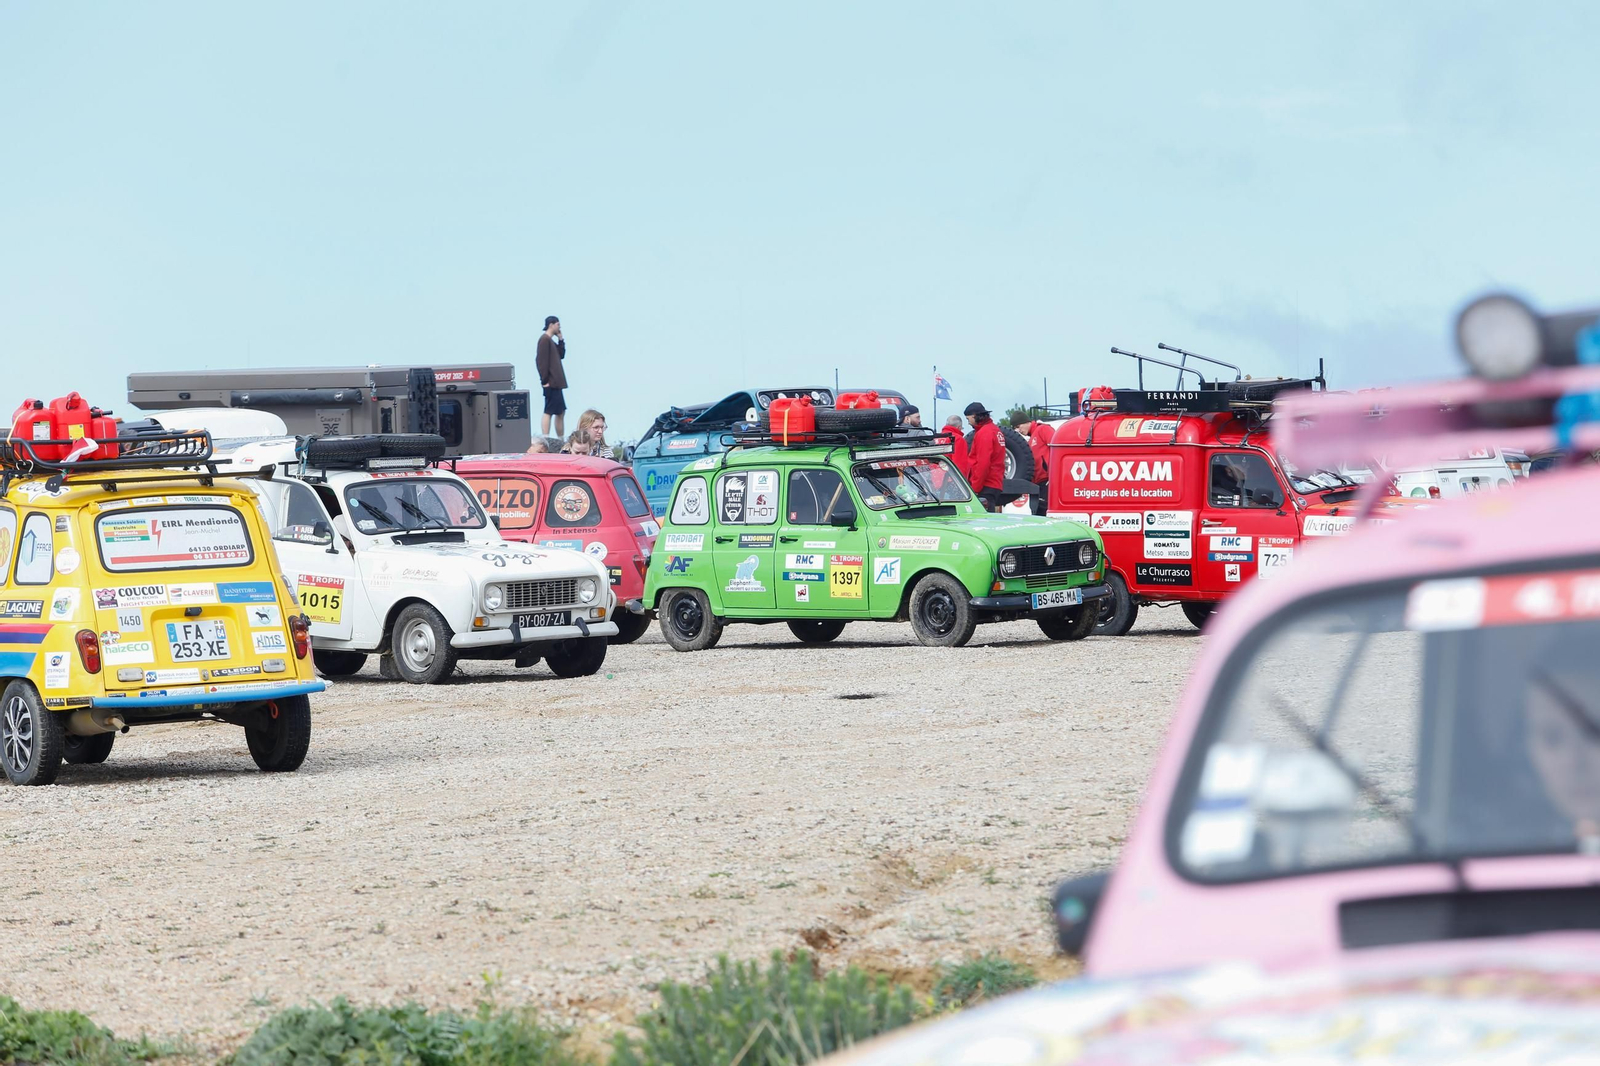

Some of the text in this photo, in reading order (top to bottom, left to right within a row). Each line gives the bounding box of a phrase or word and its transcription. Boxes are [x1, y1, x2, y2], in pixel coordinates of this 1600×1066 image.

[1147, 392, 1198, 400] FERRANDI
[1090, 461, 1172, 481] LOXAM
[657, 474, 677, 484] DAV
[478, 489, 534, 508] OZZO
[1074, 488, 1172, 498] Exigez plus de la location
[748, 508, 774, 516] THOT
[186, 517, 239, 527] Mendiondo
[667, 534, 703, 543] TRADIBAT
[1221, 537, 1241, 546] RMC
[670, 556, 693, 572] AF
[796, 555, 814, 564] RMC
[1264, 554, 1287, 566] 725
[876, 559, 899, 582] AF
[1137, 567, 1190, 577] Le Churrasco
[311, 576, 344, 585] TROPHY
[832, 571, 860, 585] 1397
[118, 586, 164, 597] COUCOU
[300, 592, 340, 609] 1015
[6, 602, 42, 613] LAGUNE
[119, 615, 141, 626] 1450
[518, 612, 565, 628] BY-087-ZA
